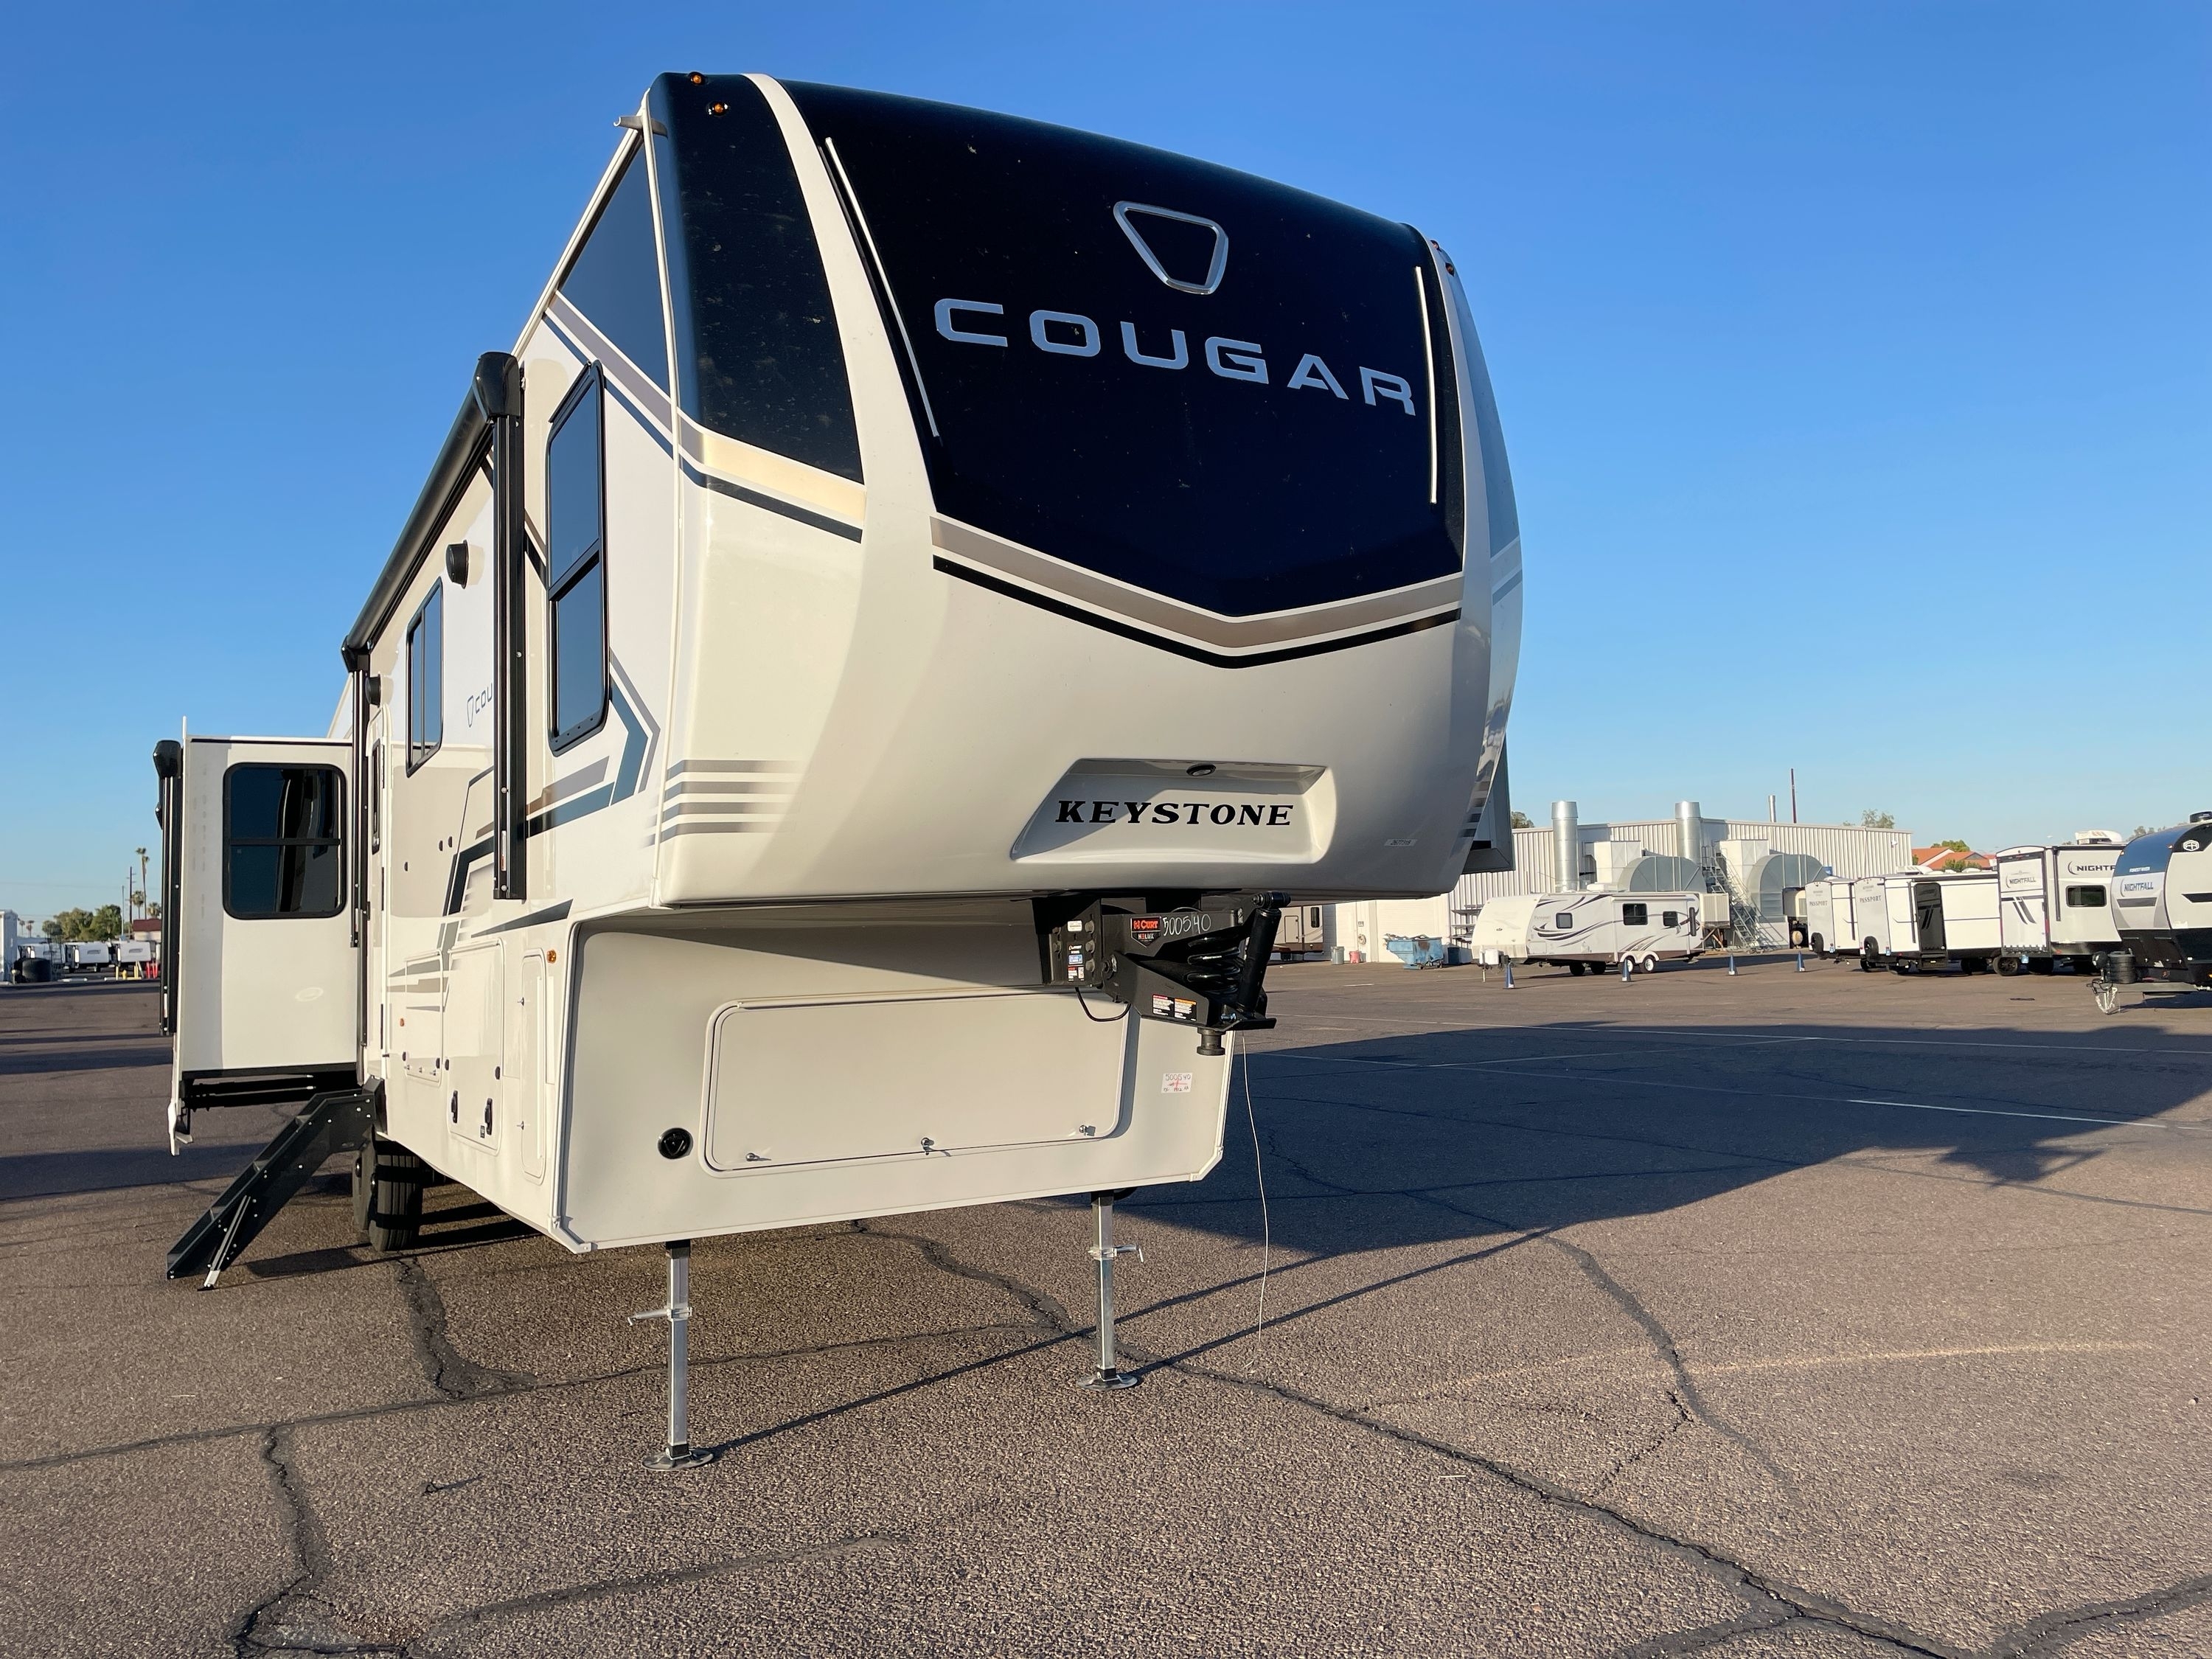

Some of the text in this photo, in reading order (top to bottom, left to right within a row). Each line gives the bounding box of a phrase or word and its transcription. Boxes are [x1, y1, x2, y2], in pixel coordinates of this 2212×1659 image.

[934, 298, 1416, 416] COUGAR
[1054, 800, 1294, 826] KEYSTONE
[2008, 877, 2037, 885] NIGHTFALL
[2124, 882, 2154, 891] NIGHTFALL
[1860, 895, 1882, 903] PASSPORT
[1140, 919, 1158, 930] CURT
[1162, 914, 1211, 936] 500540
